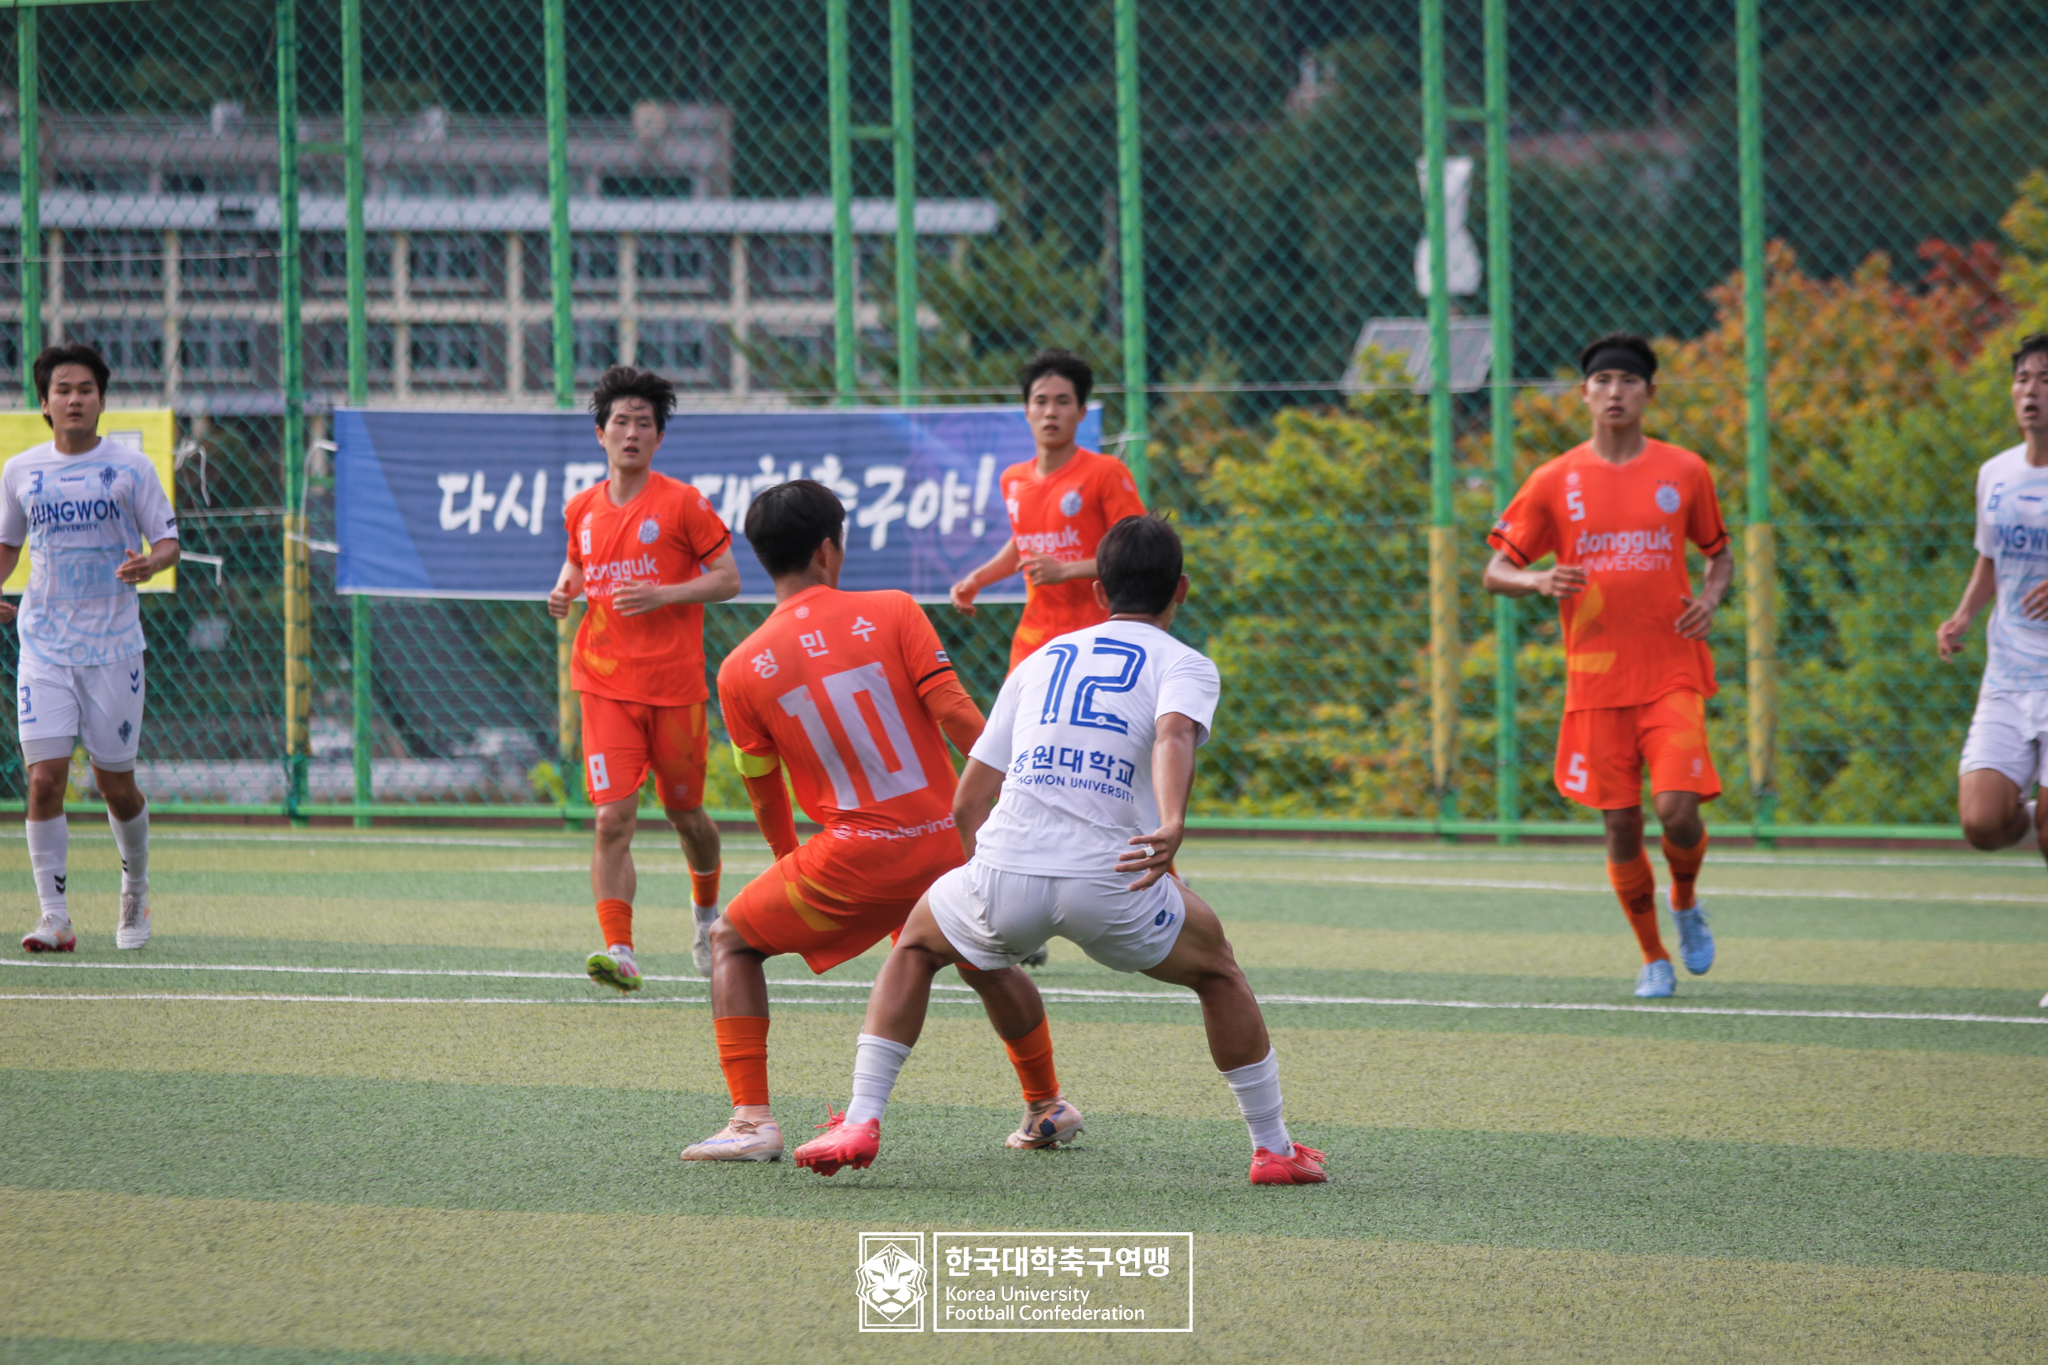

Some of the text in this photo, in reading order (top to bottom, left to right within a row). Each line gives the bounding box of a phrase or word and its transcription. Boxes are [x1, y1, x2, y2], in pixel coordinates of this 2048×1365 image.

[29, 470, 44, 496] 3
[31, 499, 121, 527] JUNGWON
[437, 468, 548, 536] 다시
[1566, 490, 1586, 522] 5
[51, 522, 99, 534] UNIVERSITY
[1015, 525, 1082, 553] ongguk
[1576, 525, 1673, 556] dongguk
[1040, 637, 1147, 736] 12
[777, 661, 929, 811] 10
[588, 753, 610, 792] 8
[1565, 753, 1589, 793] 5
[1070, 777, 1135, 804] UNIVERSITY
